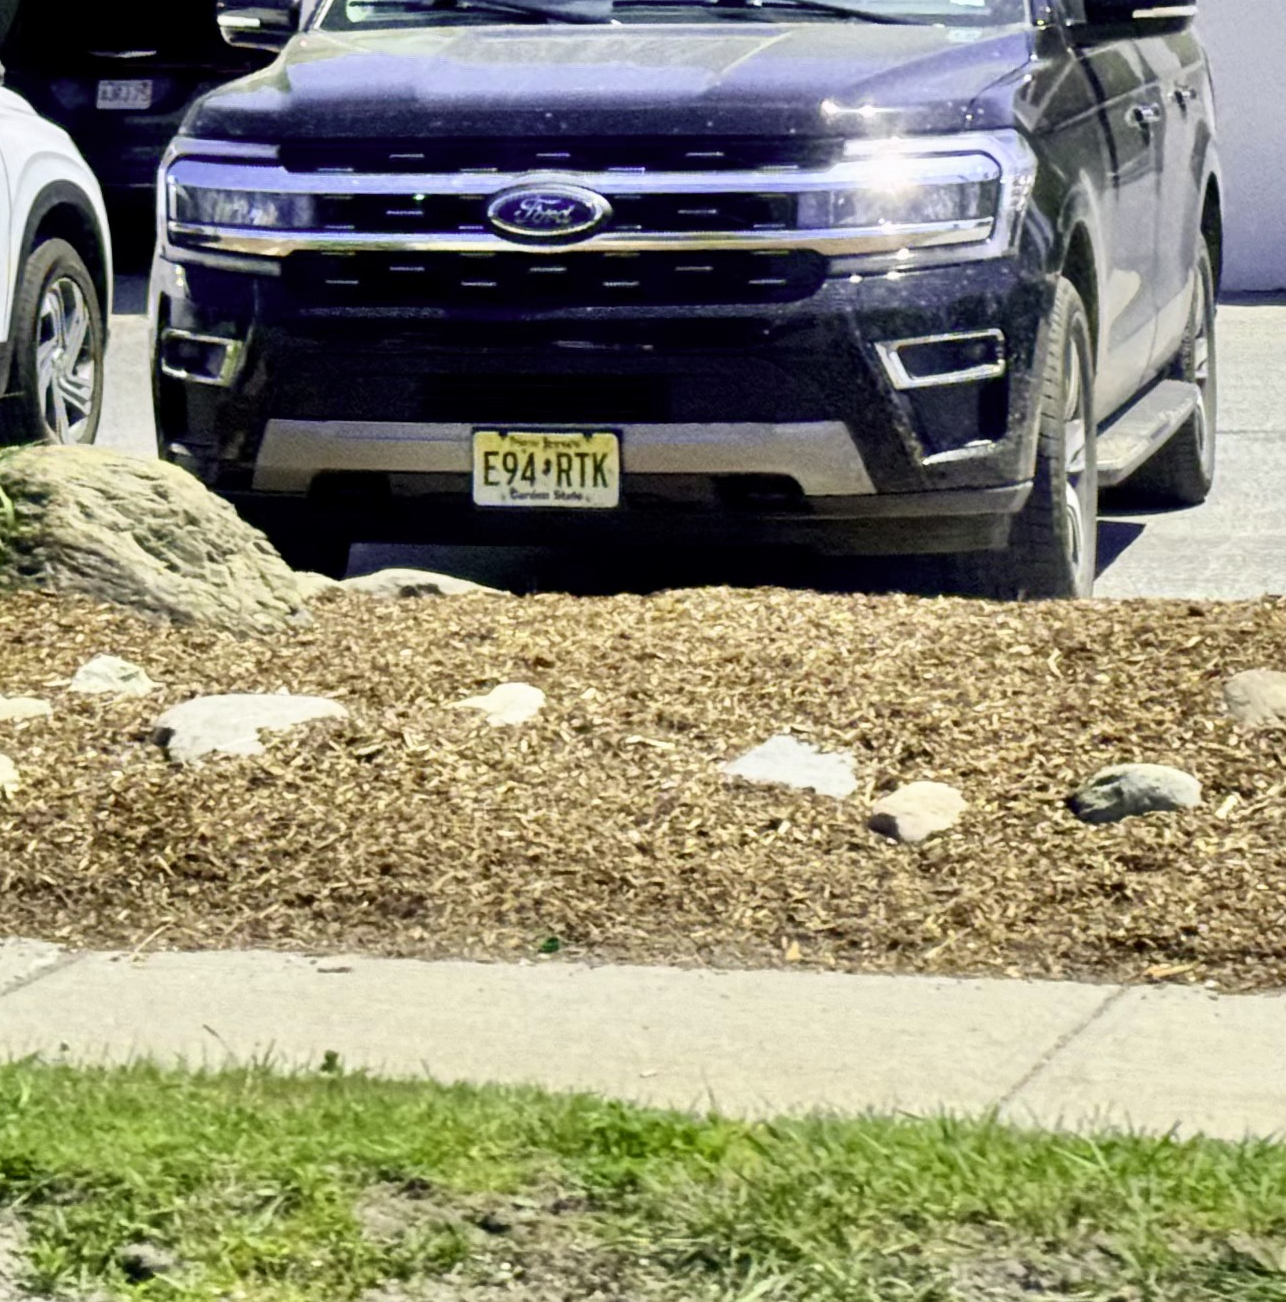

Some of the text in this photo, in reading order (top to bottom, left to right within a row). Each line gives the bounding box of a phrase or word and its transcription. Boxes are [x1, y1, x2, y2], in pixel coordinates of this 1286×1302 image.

[514, 197, 576, 224] Ford
[510, 487, 583, 501] Garden State
